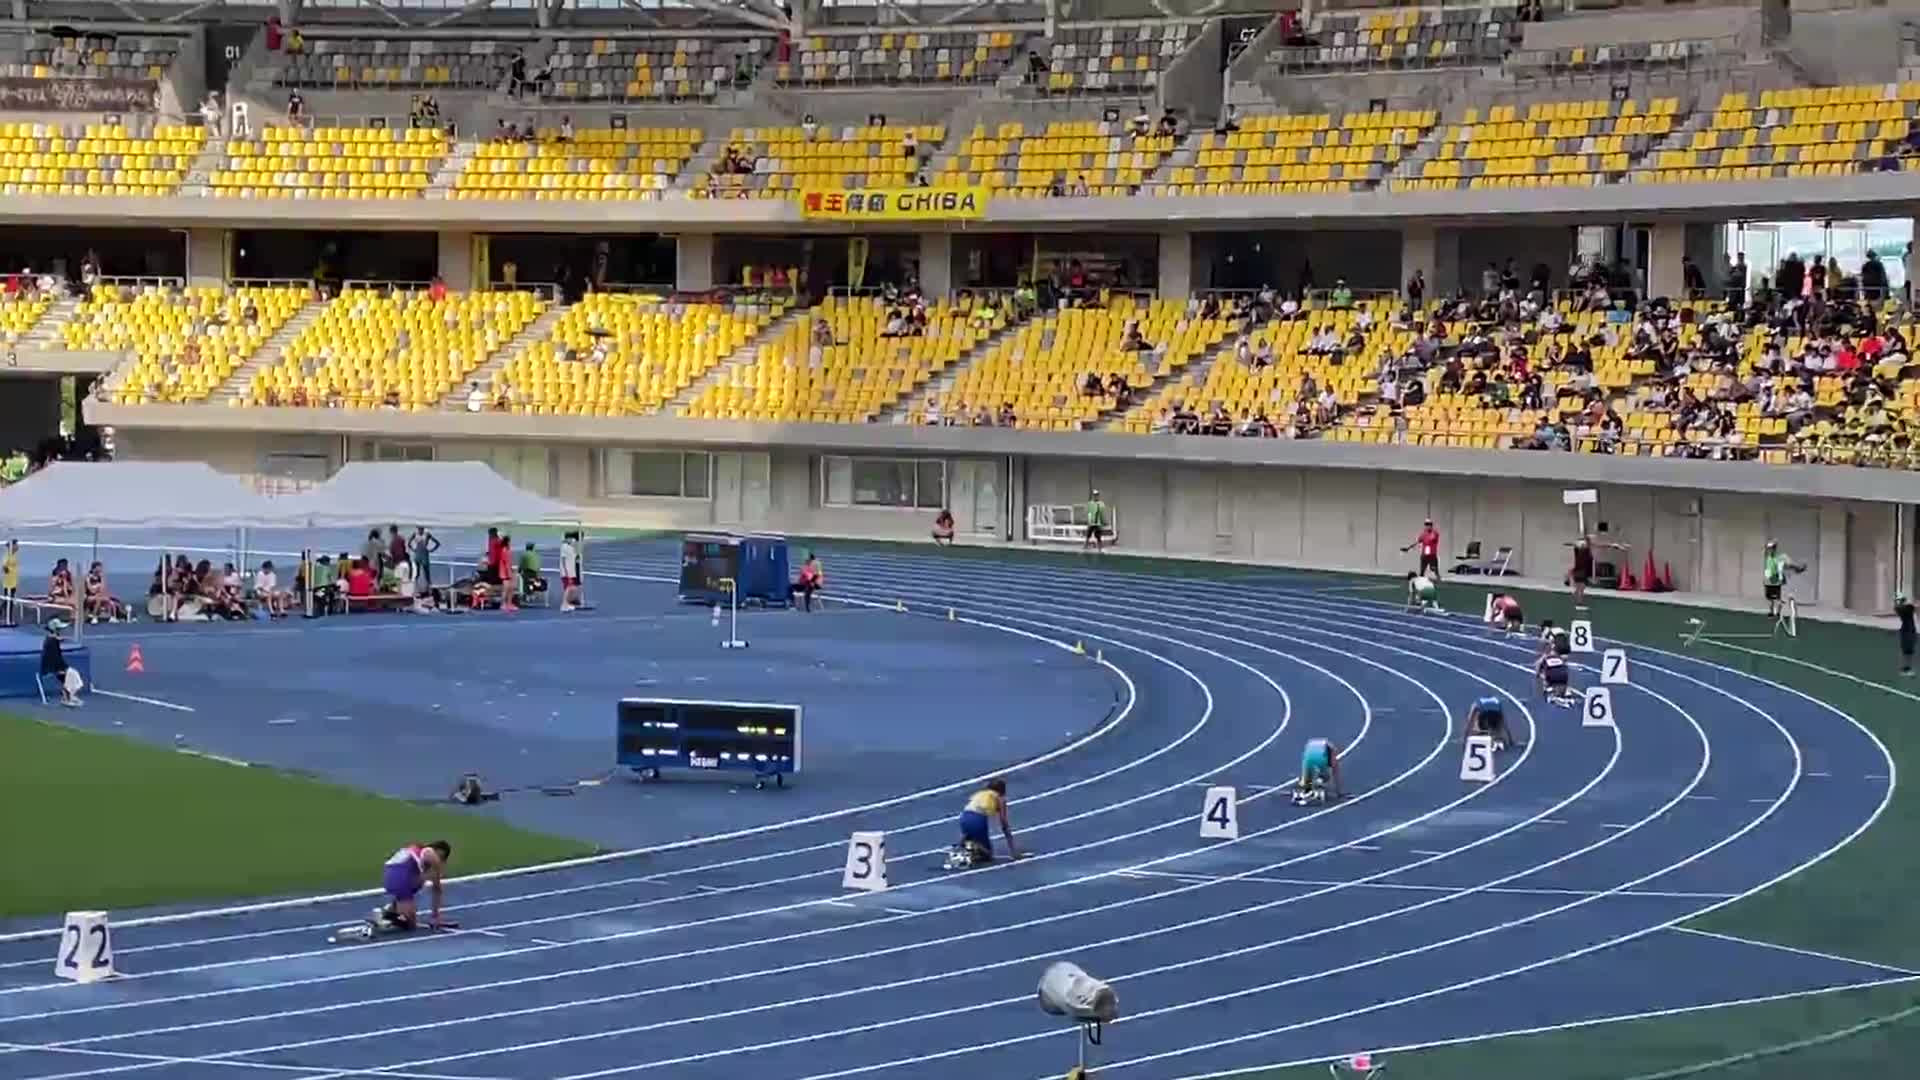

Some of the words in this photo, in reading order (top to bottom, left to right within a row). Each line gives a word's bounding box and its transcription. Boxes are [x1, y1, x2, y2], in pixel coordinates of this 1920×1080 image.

[896, 191, 976, 212] CHIBA
[1575, 626, 1588, 647] 8
[1607, 655, 1622, 678] 7
[1589, 694, 1606, 720] 6
[1468, 743, 1487, 772] 5
[1207, 796, 1230, 830] 4
[852, 842, 873, 879] 3
